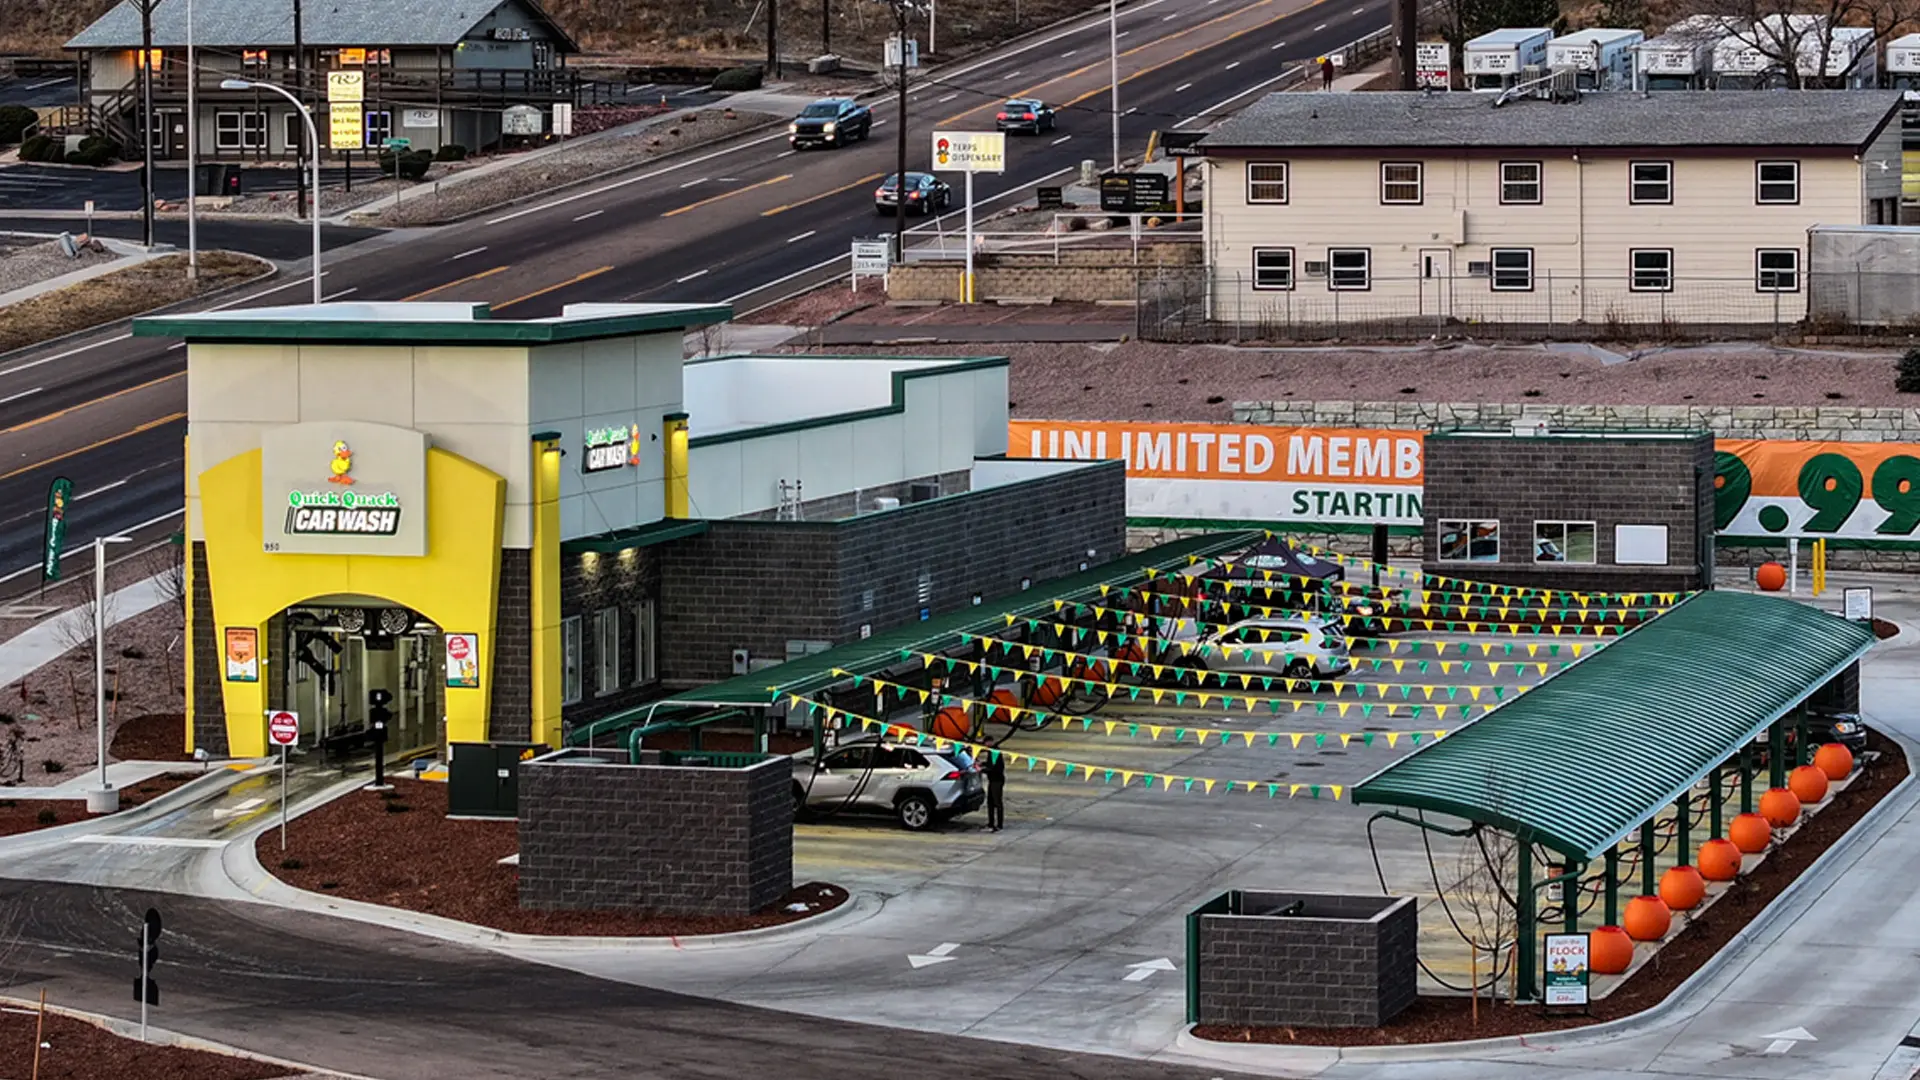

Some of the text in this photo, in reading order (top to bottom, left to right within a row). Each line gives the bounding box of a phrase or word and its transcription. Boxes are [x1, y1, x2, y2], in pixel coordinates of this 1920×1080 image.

[952, 143, 977, 151] TERPS
[952, 154, 1002, 162] DISPENSARY
[289, 490, 398, 508] Quick Quack
[295, 509, 397, 533] CAR WASH
[264, 543, 280, 551] 950
[1549, 946, 1585, 955] FLOCK
